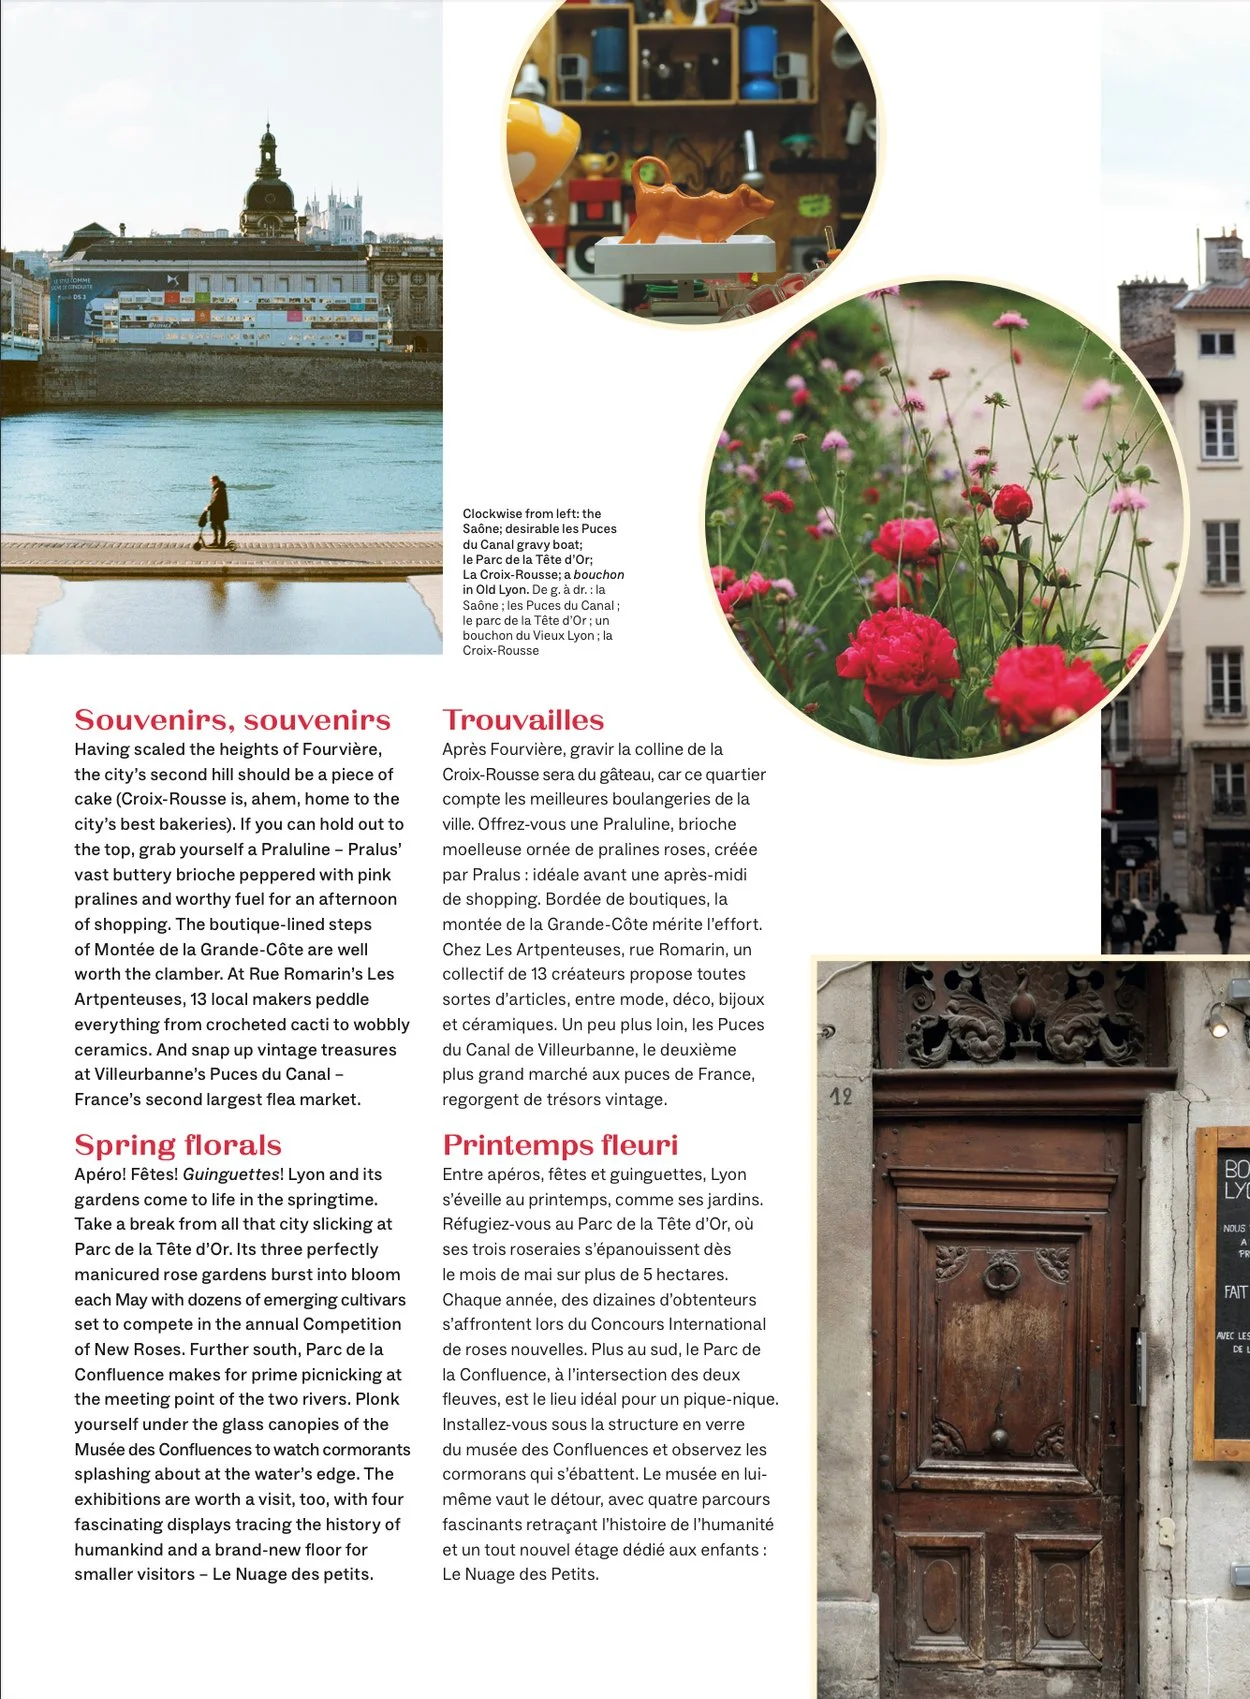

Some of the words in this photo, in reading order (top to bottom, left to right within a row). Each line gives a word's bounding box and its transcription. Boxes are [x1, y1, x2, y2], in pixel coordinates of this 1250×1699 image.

[463, 508, 522, 518] Clockwise
[525, 509, 553, 518] from
[557, 509, 579, 518] left:
[582, 509, 601, 518] the
[463, 523, 502, 535] Saône;
[506, 524, 559, 533] desirable
[563, 524, 579, 533] les
[582, 524, 617, 533] Puces
[463, 570, 477, 579] La
[480, 569, 561, 581] Croix-Rousse;
[574, 569, 624, 579] bouchon
[463, 645, 539, 655] Croix-Rousse
[76, 709, 234, 733] Souvenirs,
[244, 709, 390, 730] souvenirs
[443, 709, 604, 730] Trouvailles
[443, 967, 504, 980] collectif
[508, 967, 526, 980] de
[532, 967, 547, 980] 13
[552, 967, 625, 980] créateurs
[631, 970, 692, 983] propose
[697, 968, 745, 980] toutes
[75, 993, 186, 1009] Artpenteuses,
[191, 992, 206, 1005] 13
[212, 993, 247, 1005] local
[253, 993, 311, 1005] makers
[316, 993, 369, 1009] peddle
[830, 1086, 852, 1105] 12
[76, 1134, 176, 1161] Spring
[184, 1134, 281, 1155] florals
[445, 1134, 594, 1161] Printemps
[601, 1134, 677, 1155] fleuri
[74, 1167, 125, 1184] Apéro!
[132, 1167, 177, 1180] Fêtes!
[183, 1167, 283, 1184] Guinguettes!
[289, 1168, 324, 1184] Lyon
[330, 1168, 358, 1180] and
[364, 1168, 382, 1180] its
[1223, 1224, 1246, 1233] NOUS
[1240, 1238, 1247, 1246] A
[1224, 1285, 1249, 1299] FAIT
[1216, 1331, 1234, 1340] AVEC
[1233, 1345, 1243, 1354] DE
[444, 1418, 547, 1430] Installez-vous
[552, 1421, 587, 1430] sous
[592, 1418, 604, 1430] la
[609, 1419, 678, 1430] structure
[683, 1421, 701, 1430] en
[706, 1421, 744, 1430] verre
